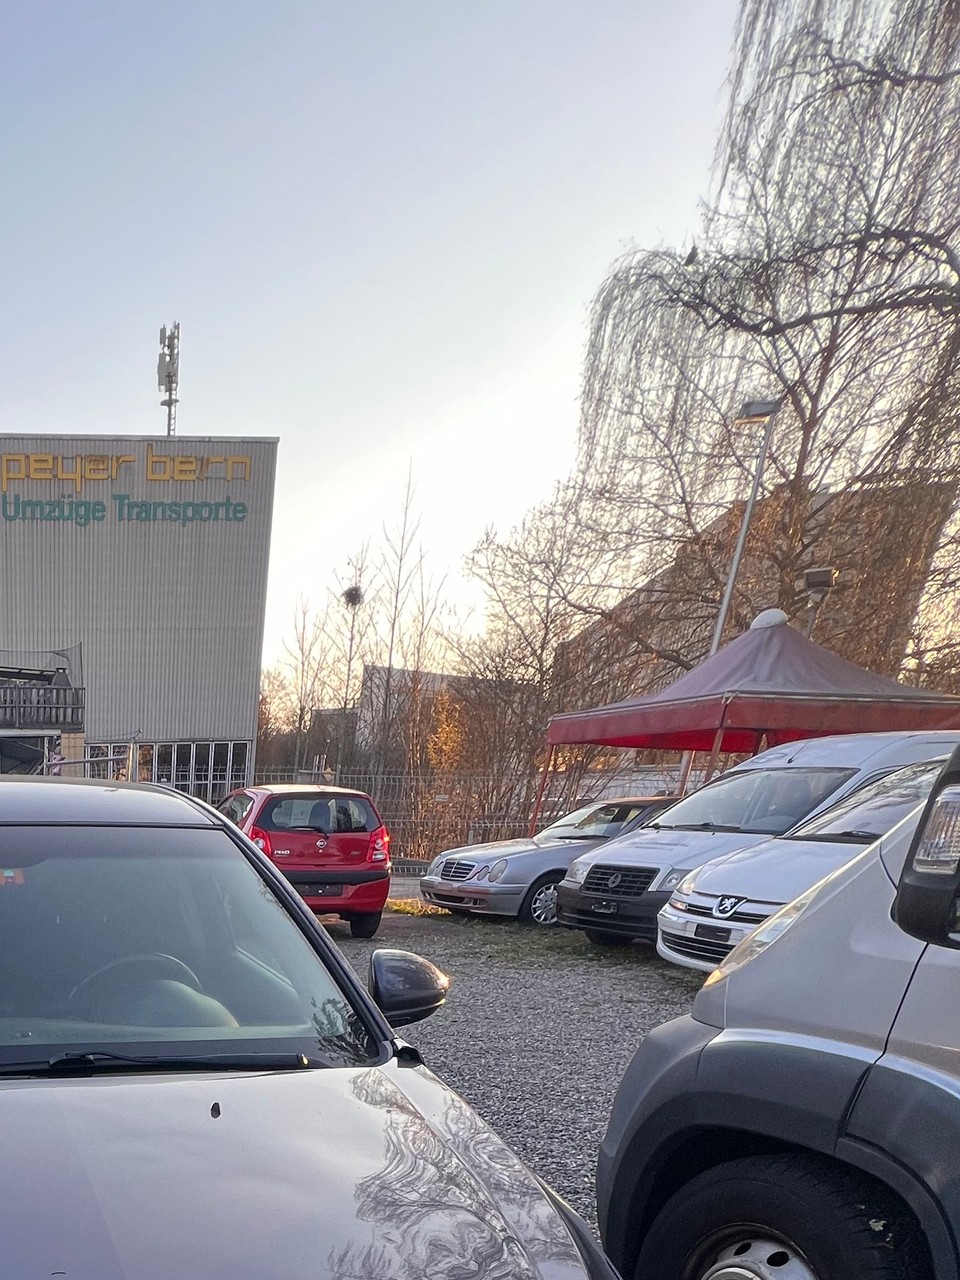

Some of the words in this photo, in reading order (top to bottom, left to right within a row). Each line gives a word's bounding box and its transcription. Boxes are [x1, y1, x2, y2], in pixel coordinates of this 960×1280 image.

[1, 454, 136, 492] peyer
[146, 443, 251, 481] bern
[1, 492, 107, 527] Umzüge
[112, 493, 248, 527] Transporte
